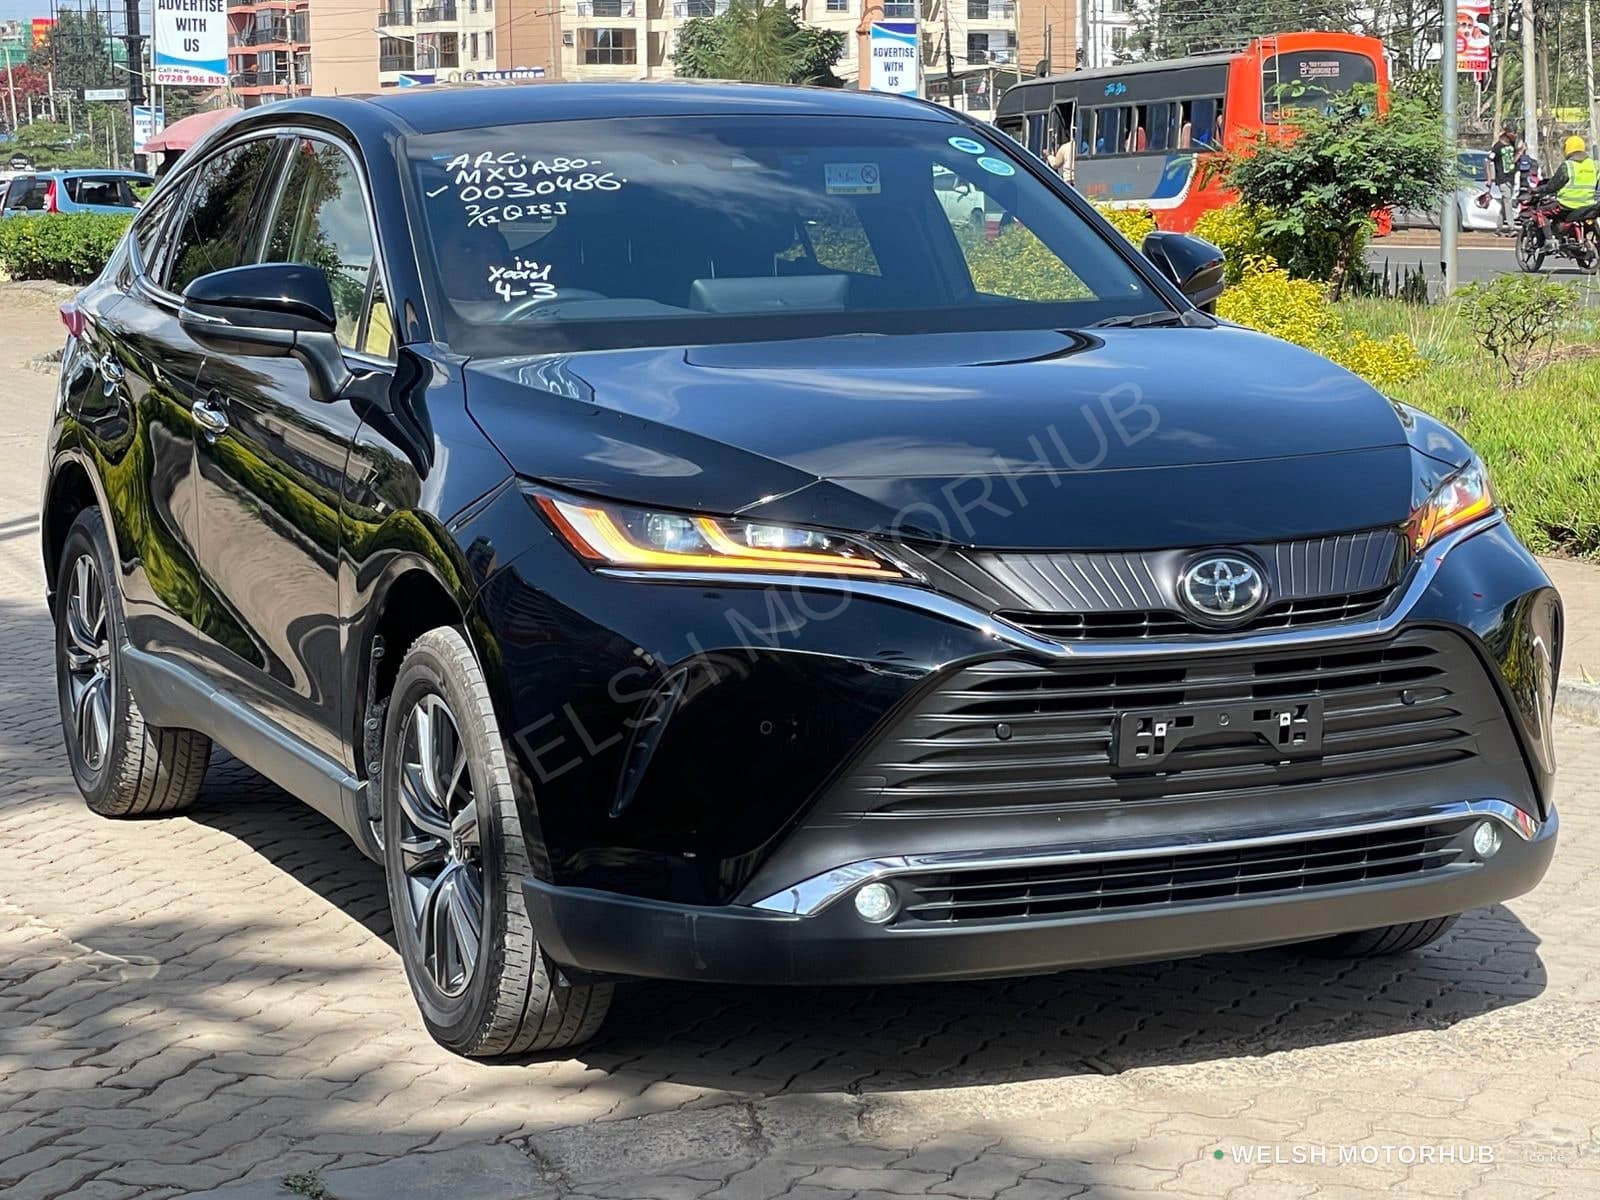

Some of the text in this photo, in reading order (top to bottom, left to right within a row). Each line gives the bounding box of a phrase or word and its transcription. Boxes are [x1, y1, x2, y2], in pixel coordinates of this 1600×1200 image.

[158, 0, 224, 12] ADVERTISE
[176, 17, 207, 33] WITH
[184, 38, 200, 52] US
[873, 47, 915, 58] ADVERTISE
[883, 61, 904, 72] WITH
[158, 74, 183, 83] 0728
[888, 76, 899, 86] US
